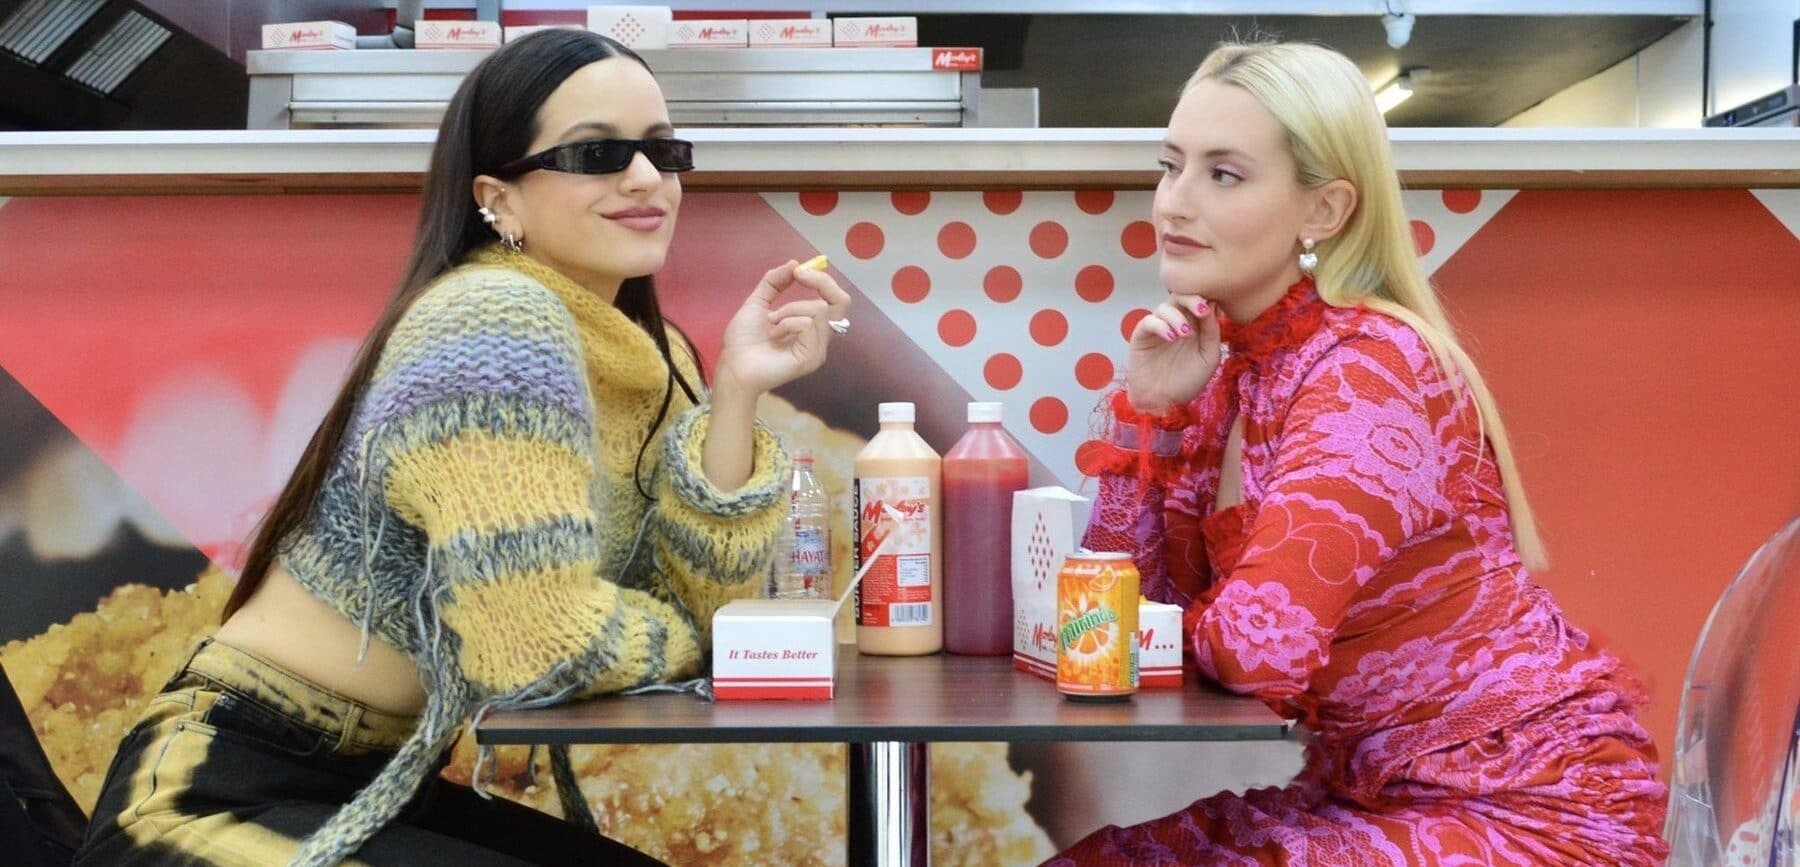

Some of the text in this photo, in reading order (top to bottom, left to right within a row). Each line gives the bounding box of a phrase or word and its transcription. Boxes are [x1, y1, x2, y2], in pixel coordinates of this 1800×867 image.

[863, 499, 925, 524] Mley's
[729, 649, 818, 660] It Tastes Better
